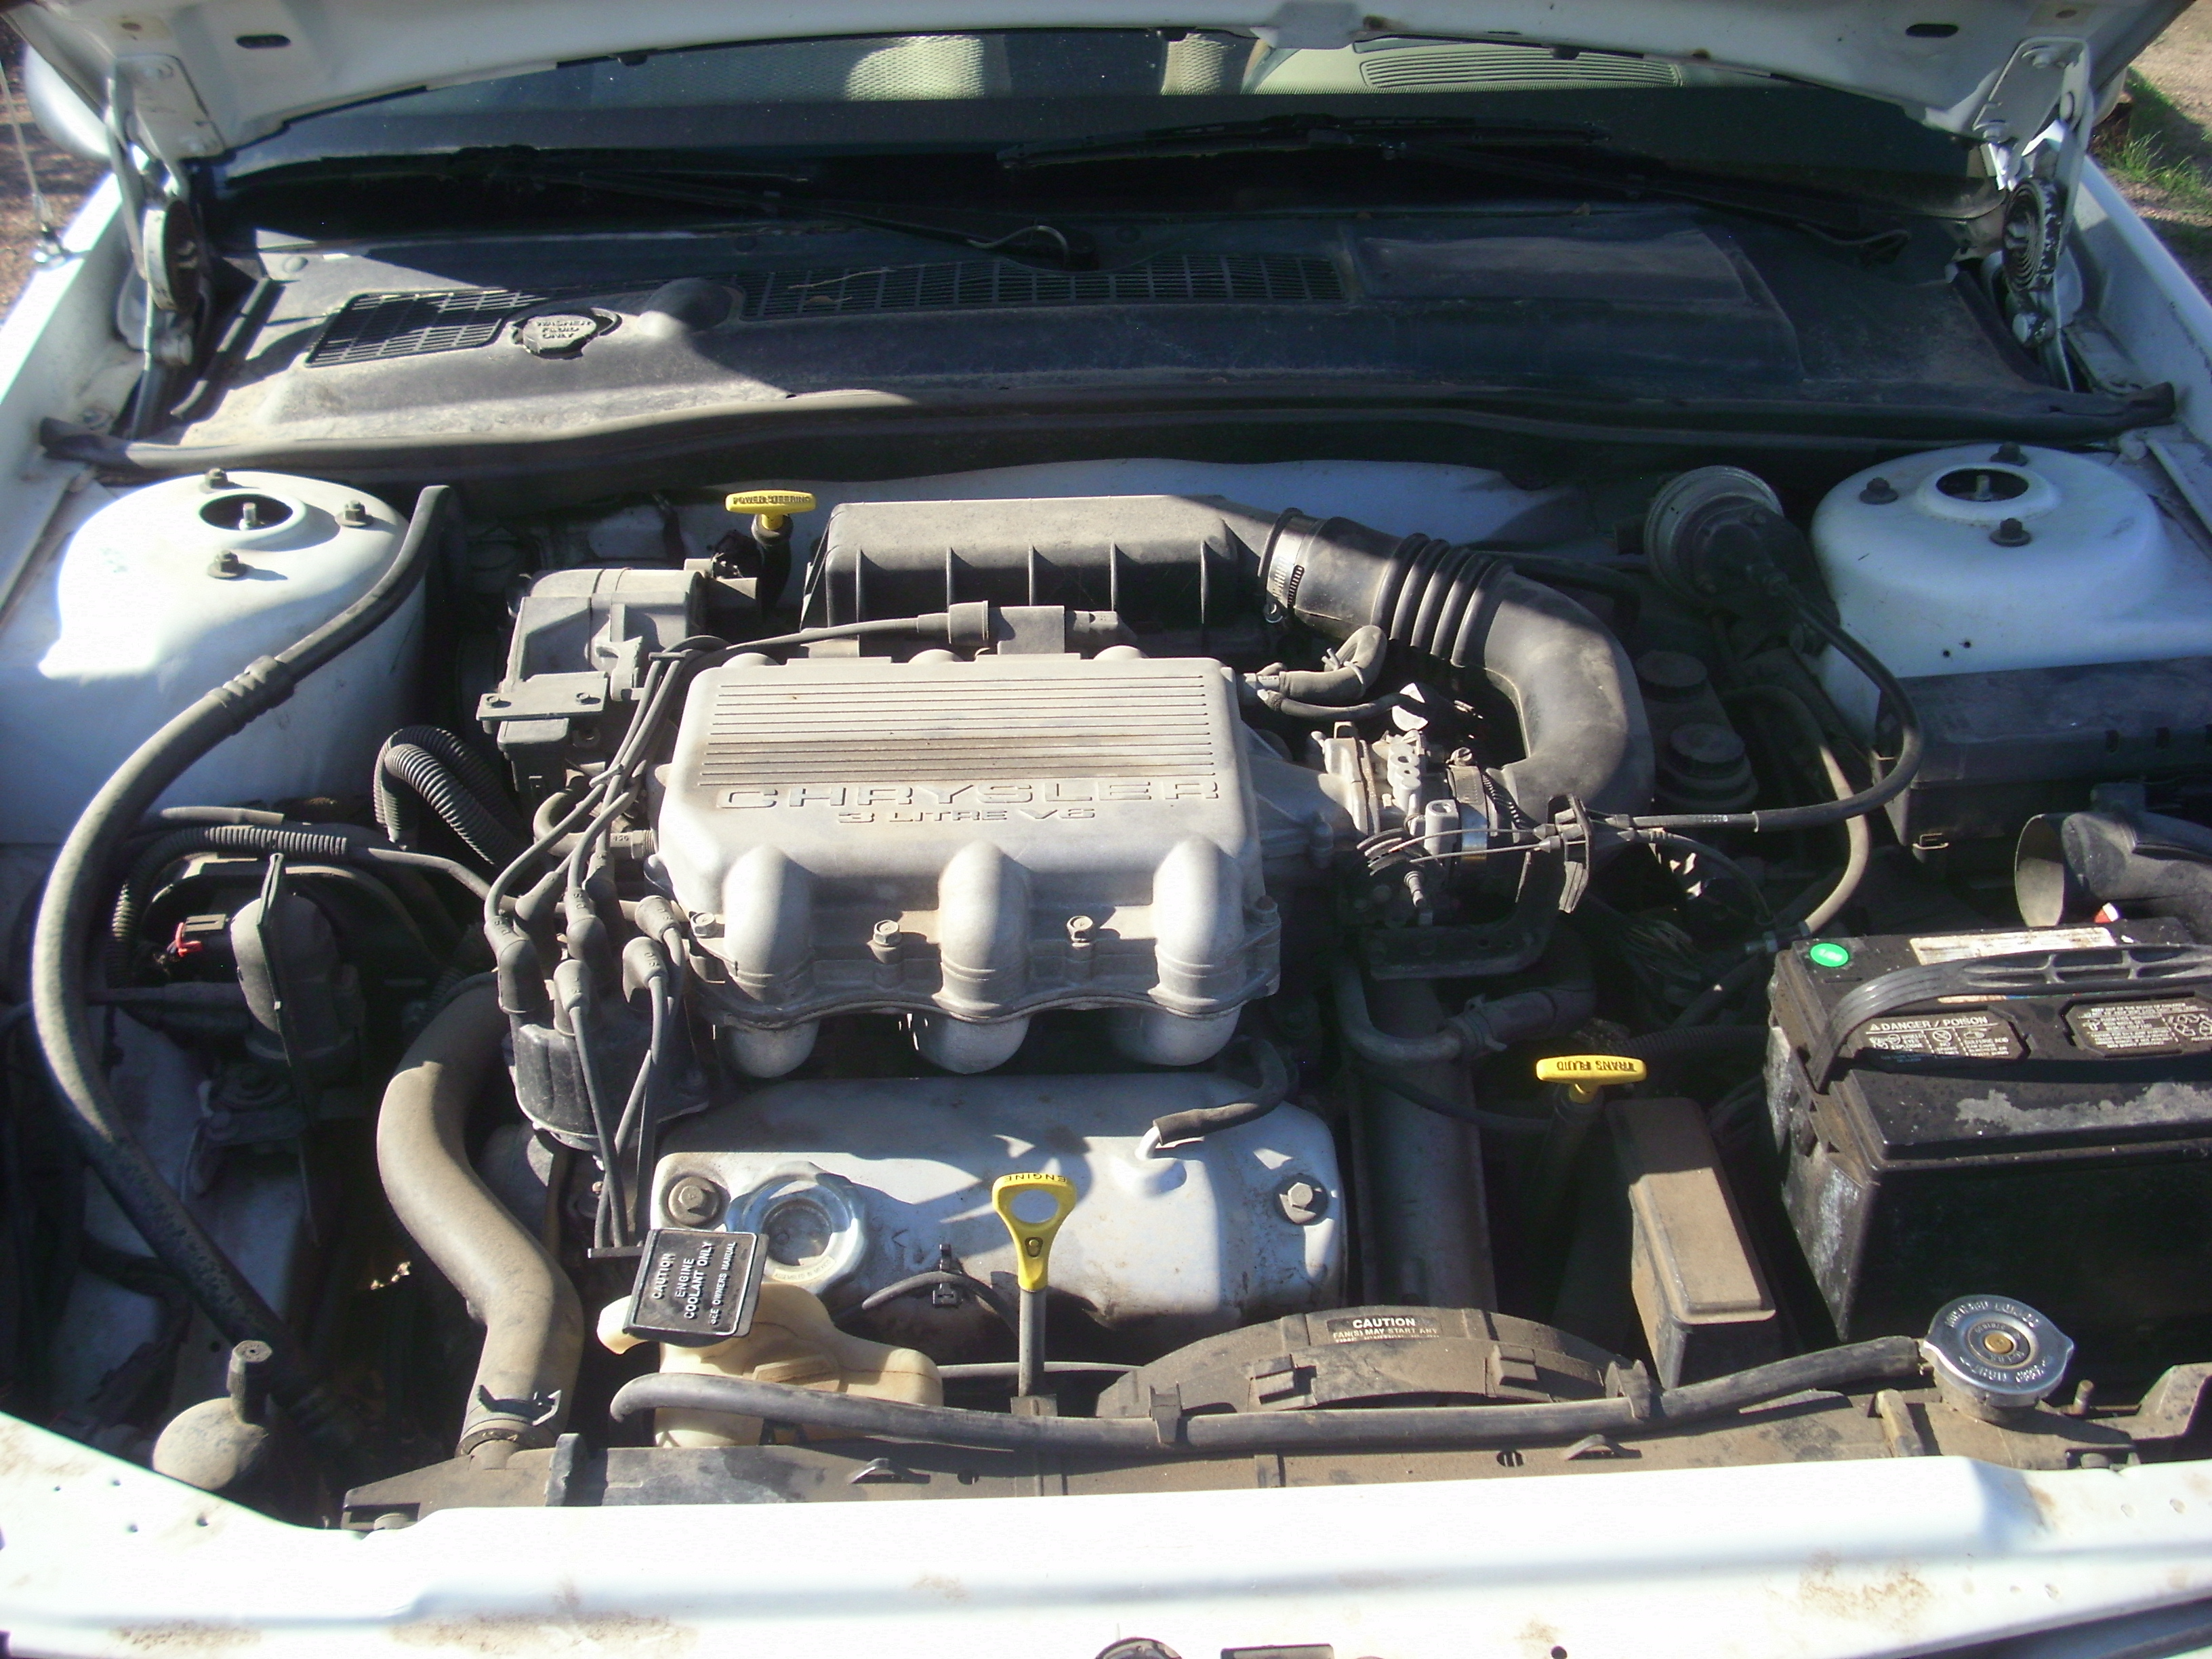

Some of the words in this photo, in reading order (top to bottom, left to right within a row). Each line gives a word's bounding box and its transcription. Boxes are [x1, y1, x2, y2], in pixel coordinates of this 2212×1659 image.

[733, 495, 766, 505] POWER
[766, 495, 811, 504] STEERING
[716, 780, 1219, 809] CHRYSLER
[838, 812, 875, 823] 3
[888, 810, 1007, 822] LITRE
[1019, 808, 1095, 819] V6
[1881, 1020, 1931, 1031] DANGER
[1942, 1016, 1988, 1027] POISON
[1557, 1060, 1592, 1071] FLUID
[1595, 1060, 1637, 1072] TRANS
[1004, 1172, 1067, 1183] ENGINE
[721, 1242, 737, 1271] MANUAL
[652, 1252, 676, 1300] CAUTION
[675, 1258, 695, 1298] ENGINE
[684, 1270, 705, 1319] COOLANT
[697, 1241, 715, 1267] ONLY
[712, 1273, 729, 1306] OWNERS
[710, 1308, 720, 1326] SEE
[1352, 1317, 1416, 1329] CAUTION
[1333, 1329, 1364, 1338] FAN(S)
[1364, 1328, 1385, 1336] MAY
